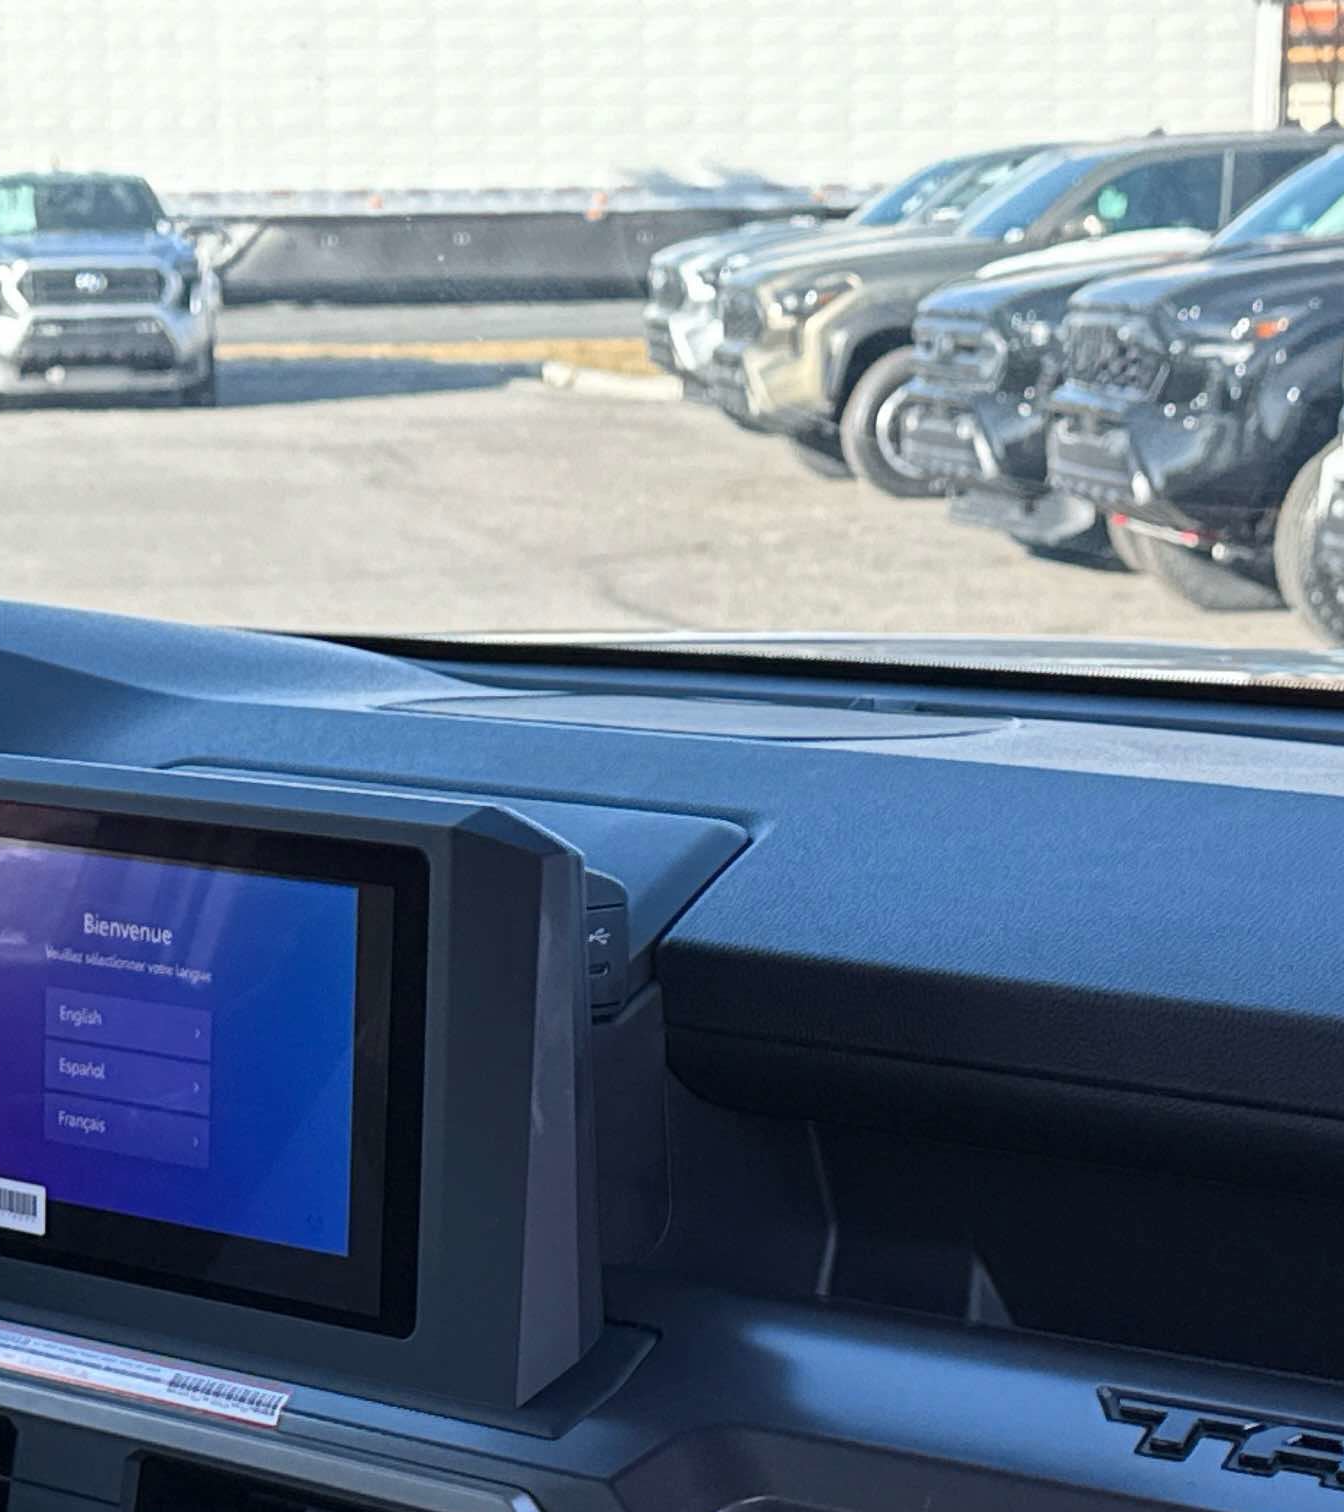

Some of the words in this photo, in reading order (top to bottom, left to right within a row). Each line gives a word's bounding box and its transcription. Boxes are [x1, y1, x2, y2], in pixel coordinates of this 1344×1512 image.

[83, 912, 173, 945] Bienvenue
[59, 1005, 102, 1027] English
[59, 1057, 105, 1079] Español
[58, 1110, 106, 1133] Français
